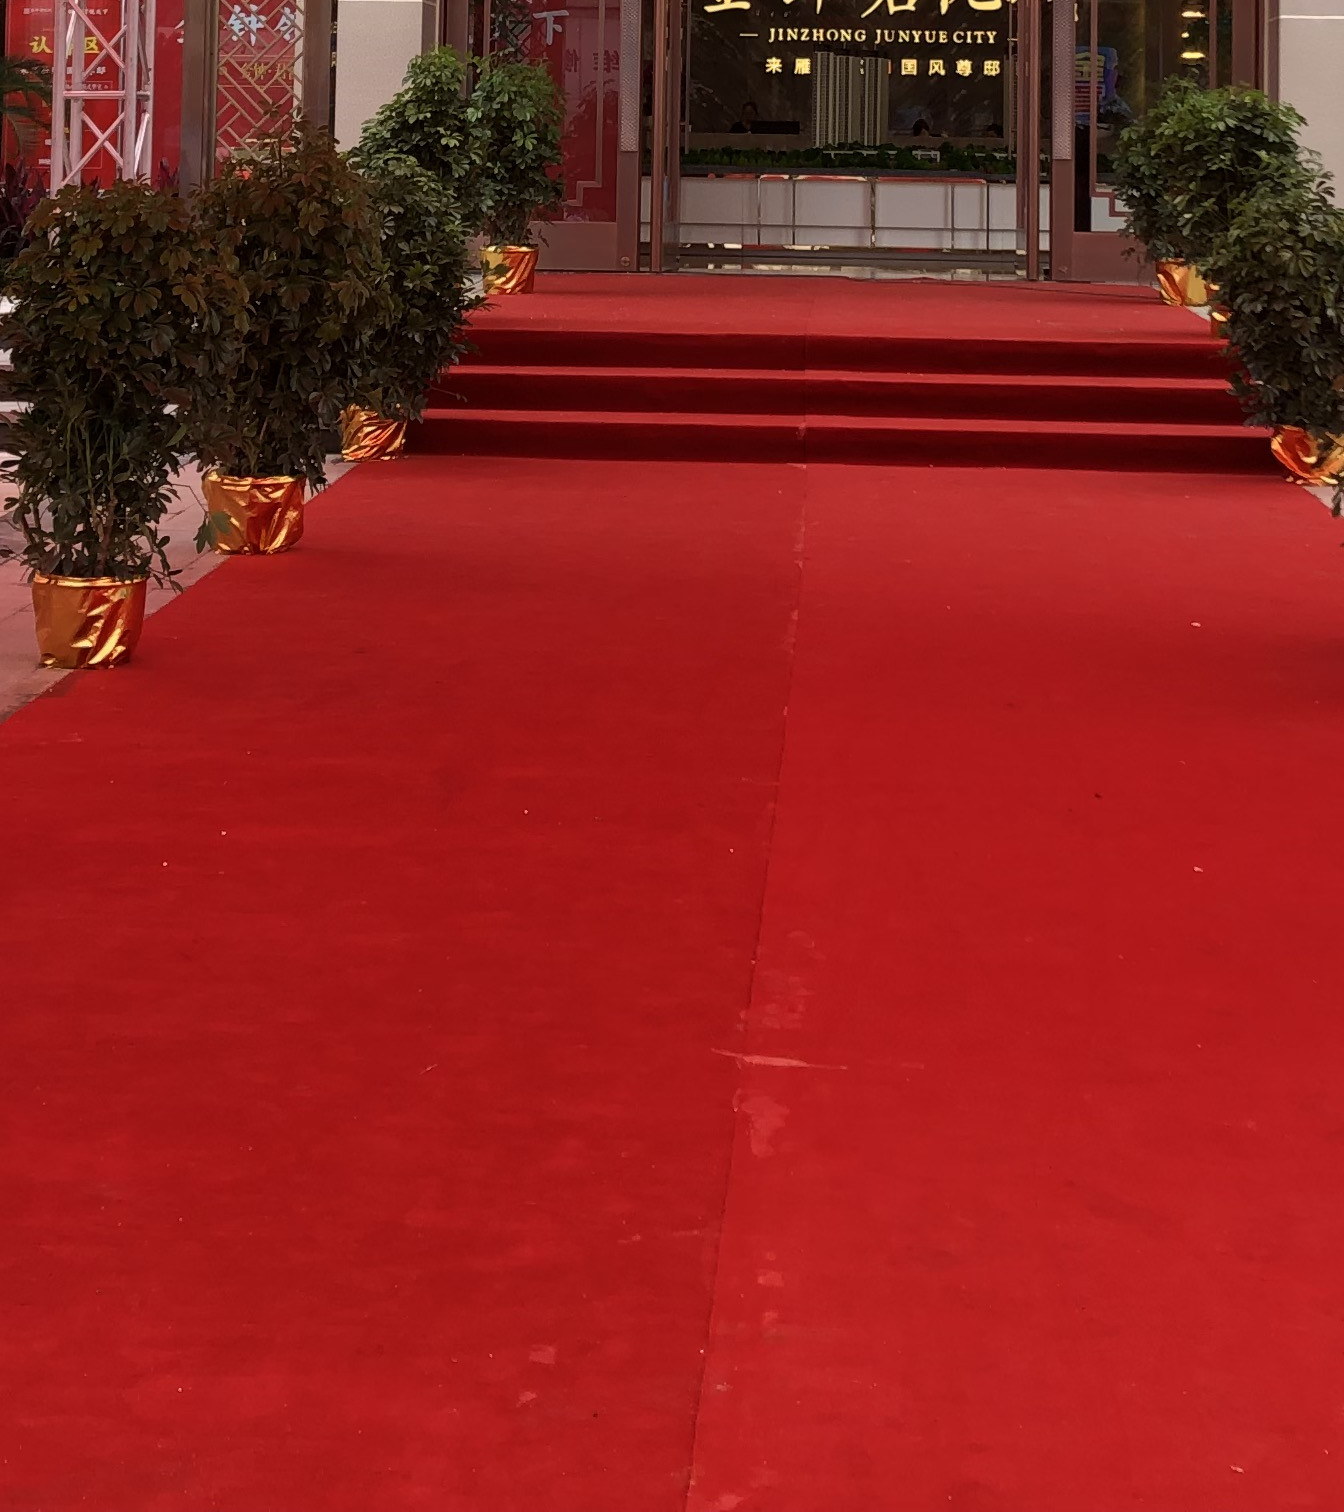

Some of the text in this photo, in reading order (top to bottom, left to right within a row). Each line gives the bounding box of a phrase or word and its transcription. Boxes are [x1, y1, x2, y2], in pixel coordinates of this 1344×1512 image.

[28, 35, 100, 56] 认区
[768, 27, 998, 45] JINZHONG JUNYUE CITY
[887, 57, 1001, 77] 国风尊邸
